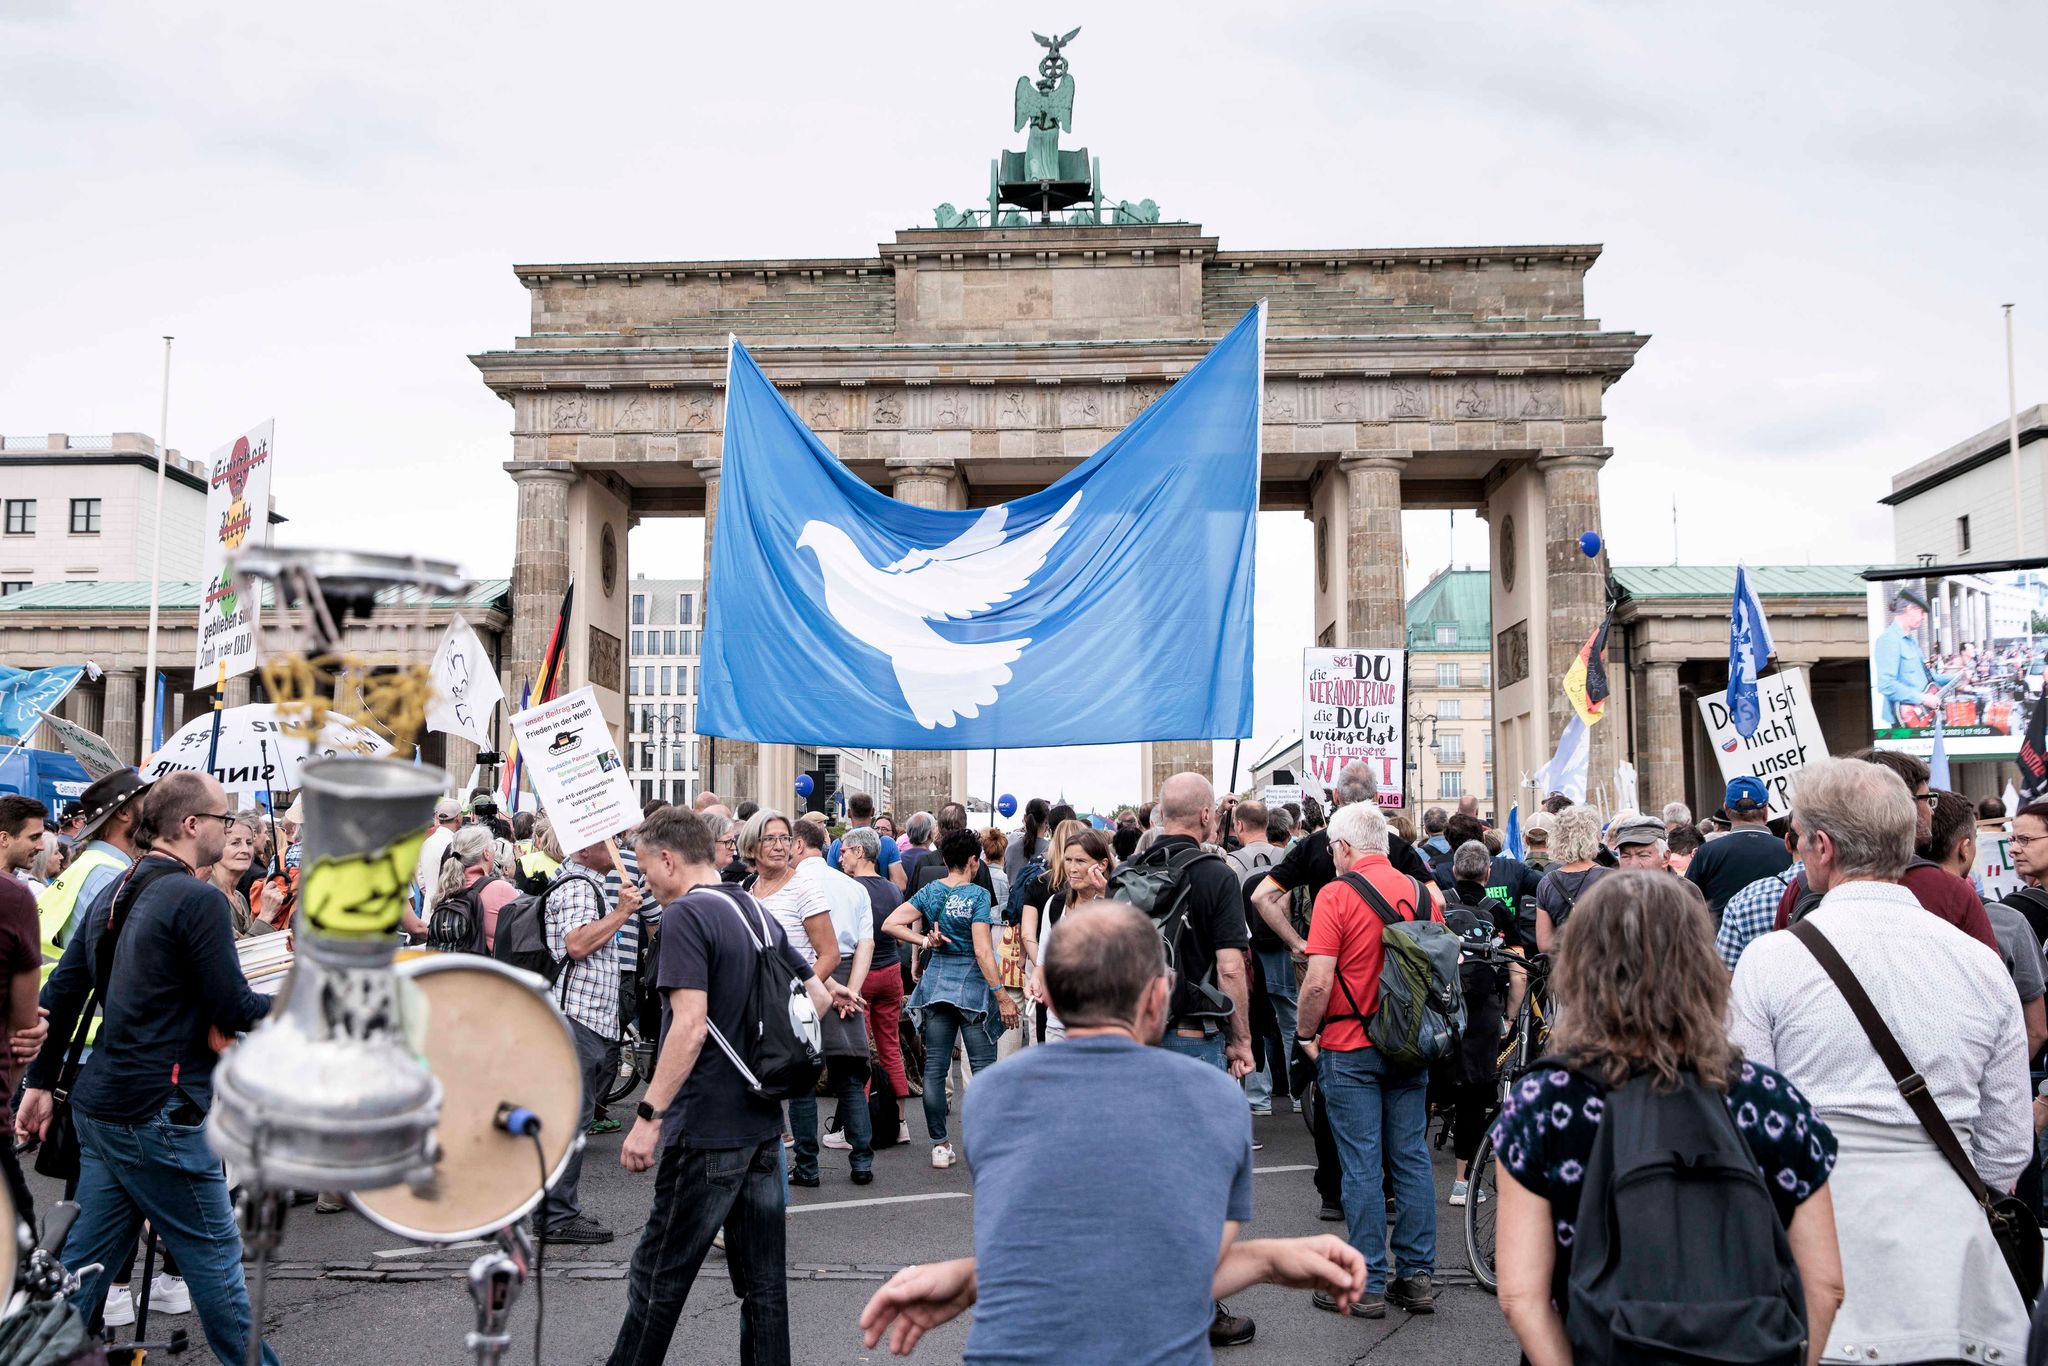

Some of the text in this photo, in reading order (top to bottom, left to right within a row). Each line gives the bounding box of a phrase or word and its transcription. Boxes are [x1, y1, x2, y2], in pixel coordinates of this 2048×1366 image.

[204, 611, 237, 644] geblieben
[1310, 668, 1327, 681] die
[1332, 654, 1391, 682] sei DU
[1309, 677, 1396, 706] VERÄNDERUNG
[1767, 685, 1796, 712] ist
[546, 705, 571, 720] Beitrag
[572, 699, 586, 709] zum
[1314, 707, 1390, 729] die DU dir
[526, 708, 592, 739] Frieden in der Welt?
[1310, 725, 1398, 745] wünschst
[1744, 715, 1796, 750] nicht
[546, 759, 572, 773] Deutsche
[572, 753, 590, 763] Panzer
[1323, 744, 1386, 757] für unsere
[1752, 745, 1807, 777] unser
[1310, 755, 1398, 785] WT
[571, 789, 607, 807] Volksvertreter
